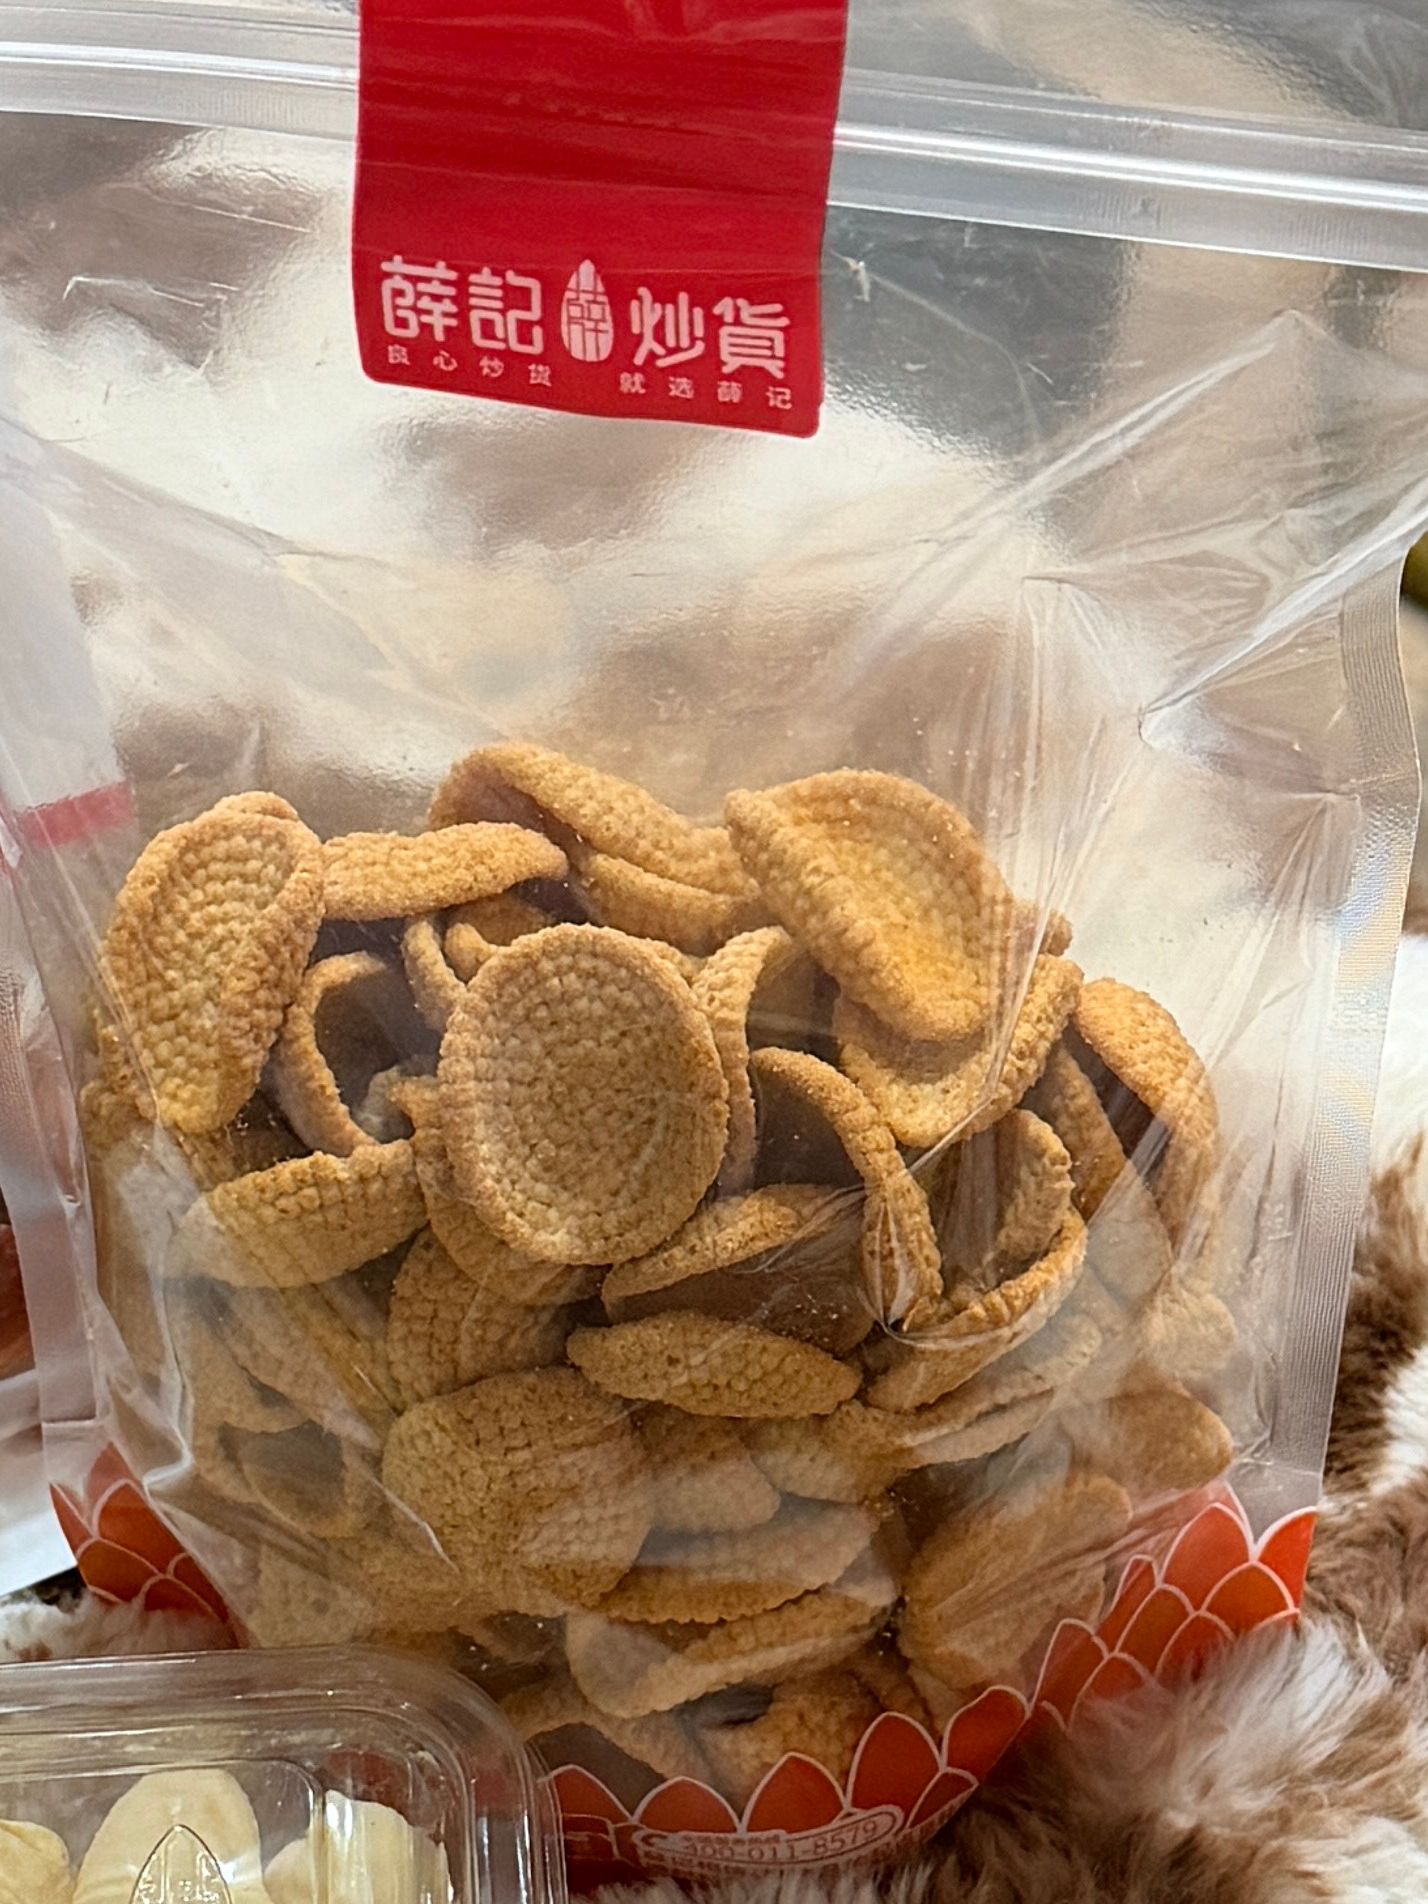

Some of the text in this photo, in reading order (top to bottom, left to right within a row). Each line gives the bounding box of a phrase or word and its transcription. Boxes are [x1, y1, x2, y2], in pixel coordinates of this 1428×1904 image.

[386, 343, 794, 411] 良心炒货 就选薛记
